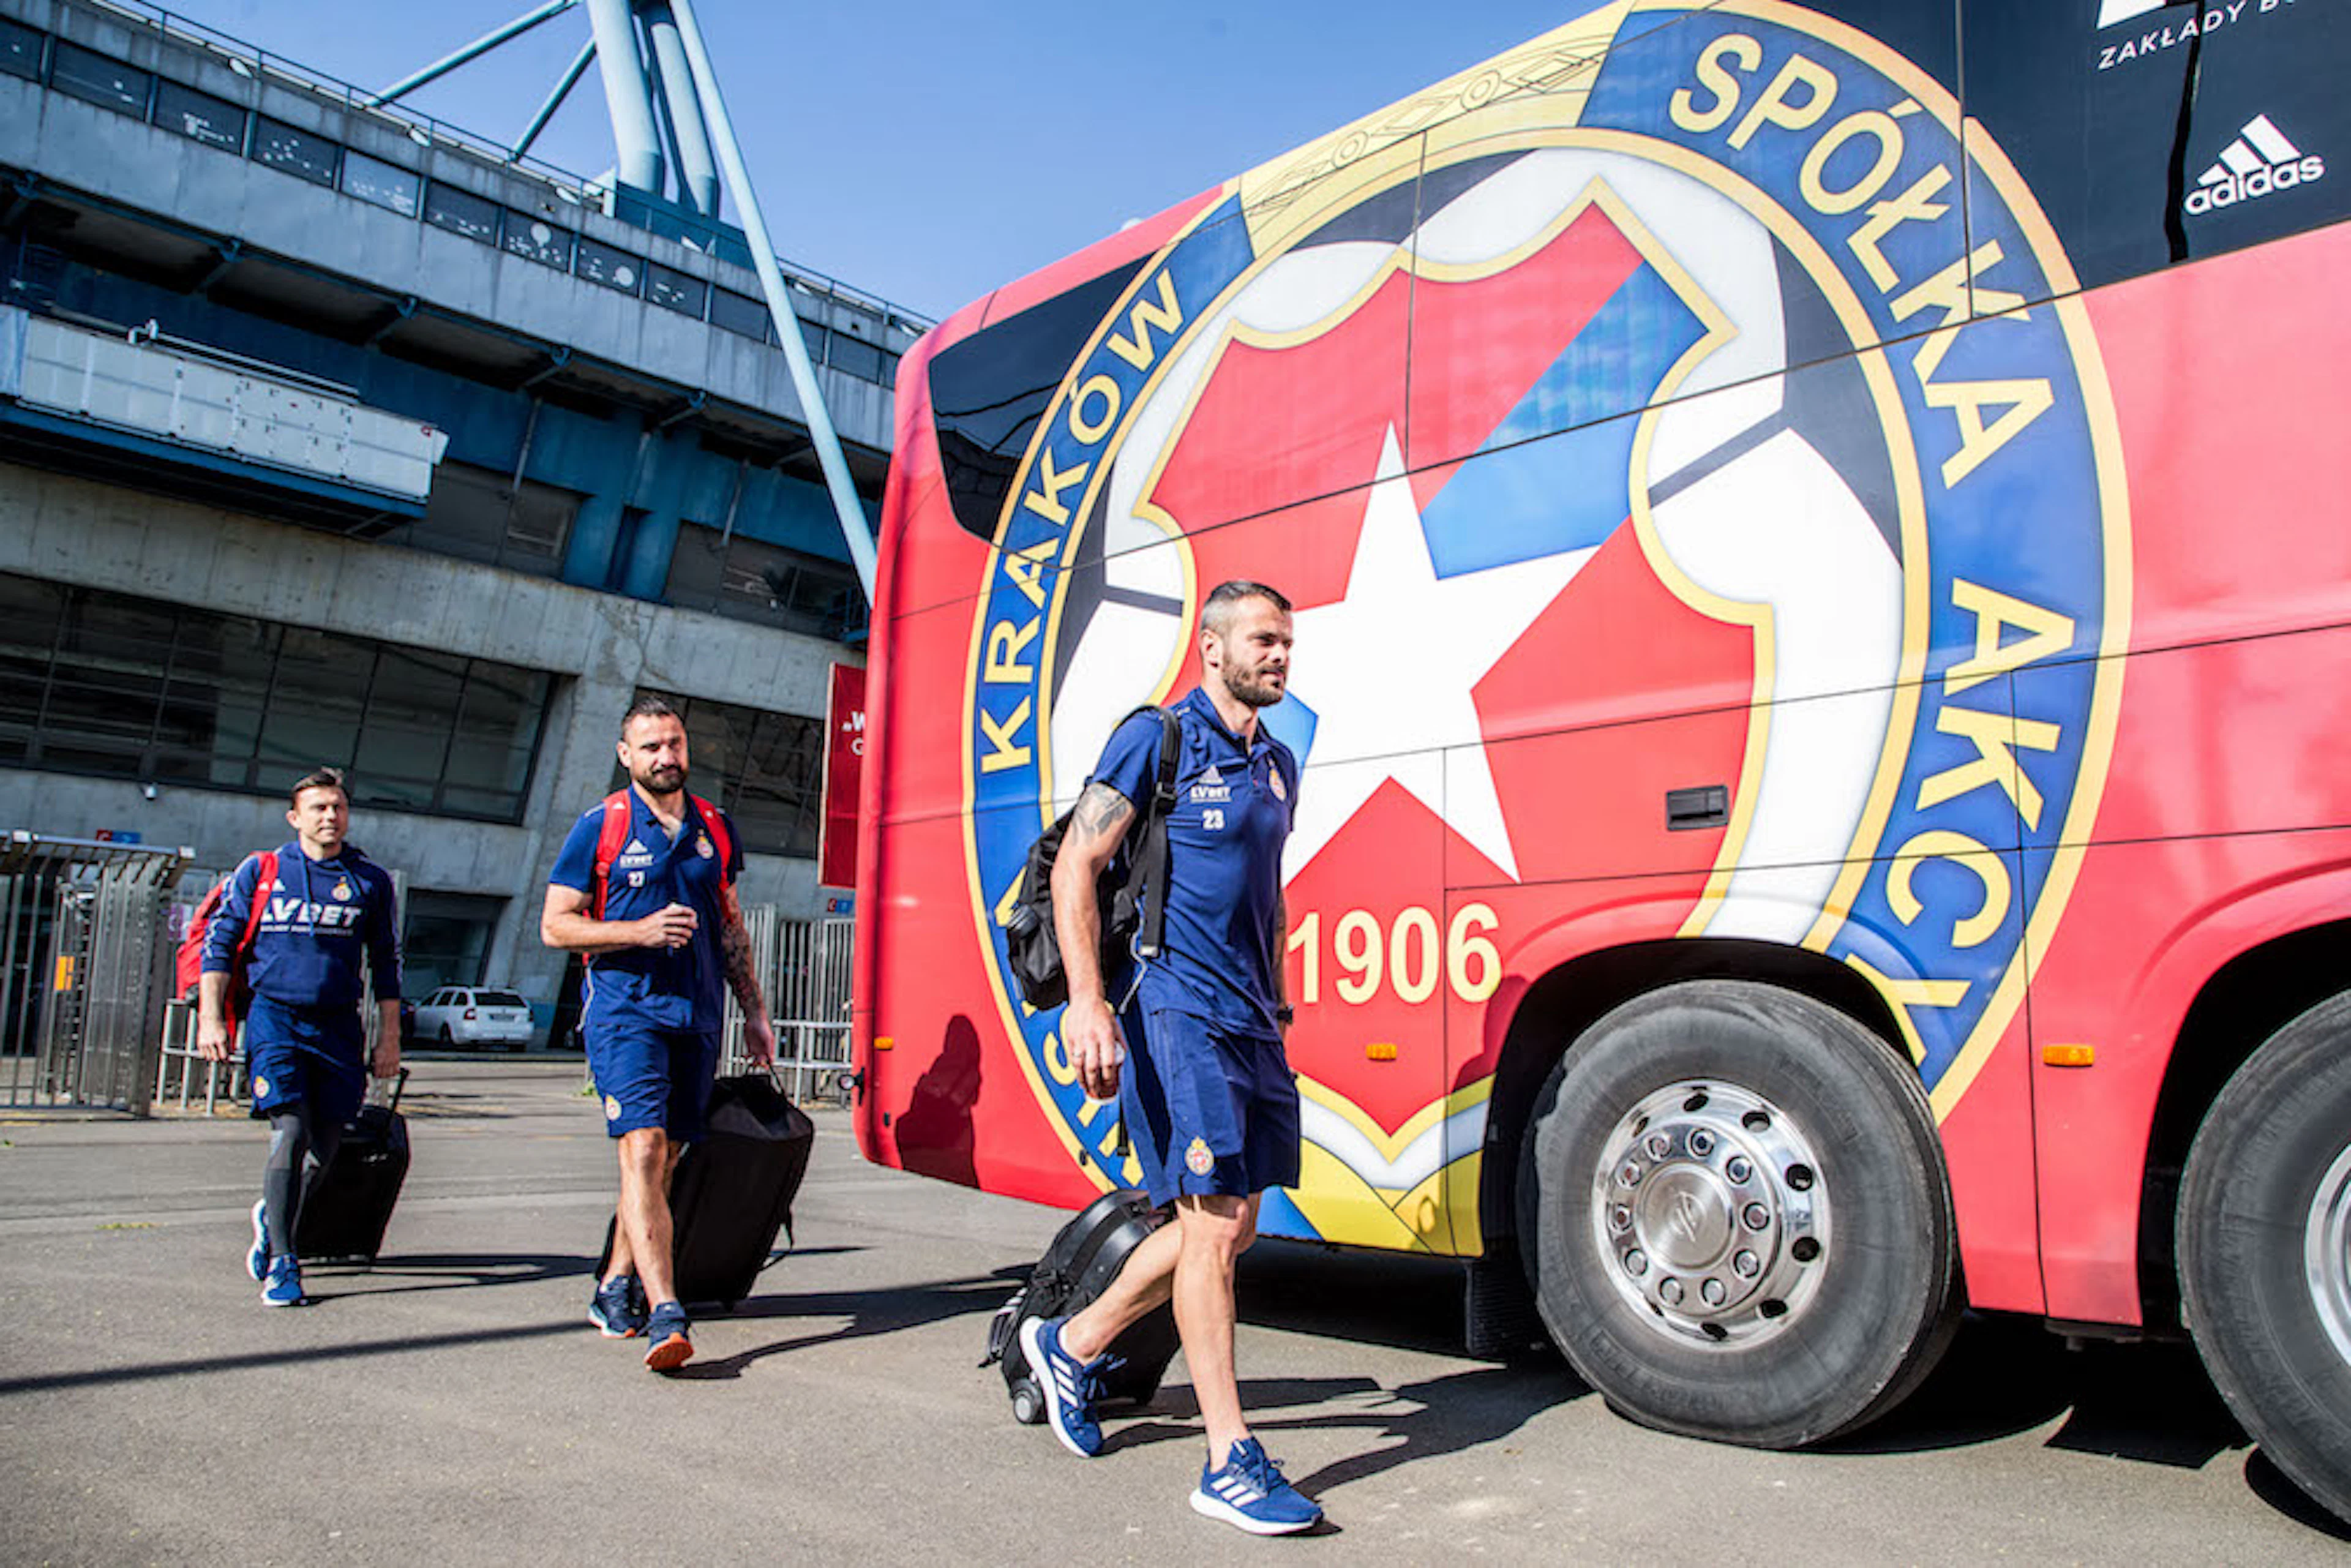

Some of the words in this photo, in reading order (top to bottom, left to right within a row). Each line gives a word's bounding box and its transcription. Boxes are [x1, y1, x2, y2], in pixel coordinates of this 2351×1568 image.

[2098, 0, 2248, 71] ZAKŁADY
[2184, 154, 2325, 216] adidas
[1670, 34, 2055, 489] SPÓŁKA
[981, 269, 1183, 773] KRAKÓW
[1202, 809, 1225, 831] 23
[1288, 902, 1502, 1005] 1906
